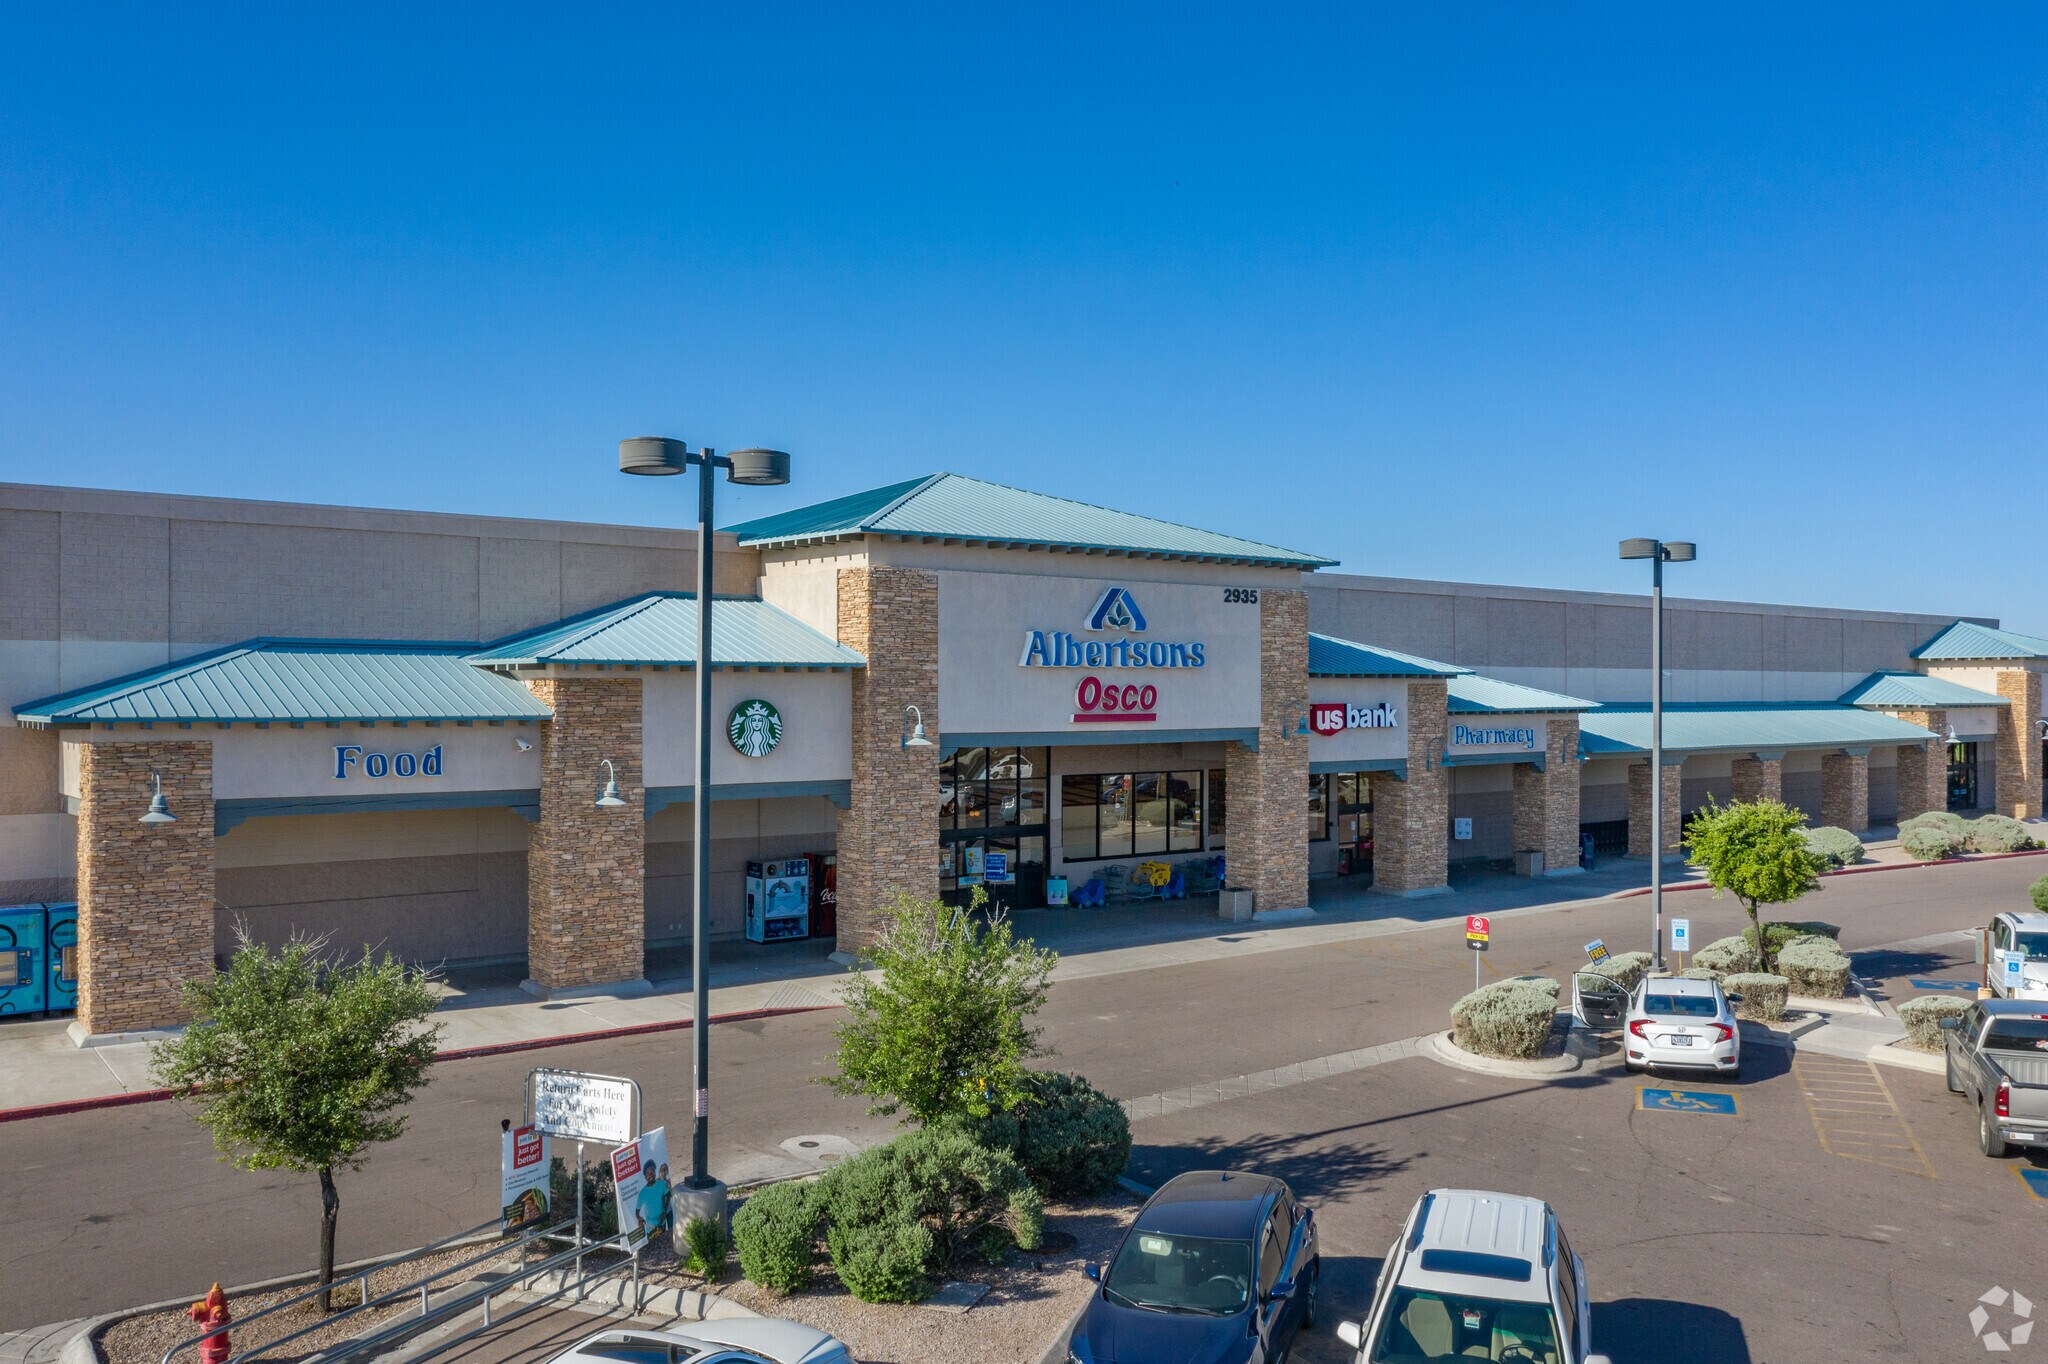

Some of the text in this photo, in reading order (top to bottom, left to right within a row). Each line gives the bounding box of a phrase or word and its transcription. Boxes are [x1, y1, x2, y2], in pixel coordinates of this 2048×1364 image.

[1223, 588, 1258, 604] 2935
[1019, 630, 1206, 669] Albertsons
[1074, 676, 1158, 712] Osco
[1316, 703, 1398, 730] us bank
[1455, 725, 1535, 749] Pharmacy
[332, 744, 444, 779] Food
[1589, 945, 1607, 960] FREE
[542, 1080, 625, 1101] Return Carts Here
[548, 1098, 617, 1119] For Your Safety
[543, 1114, 562, 1126] And
[517, 1151, 540, 1165] better!
[518, 1143, 540, 1156] just got
[617, 1156, 637, 1171] just got
[617, 1163, 638, 1178] better!
